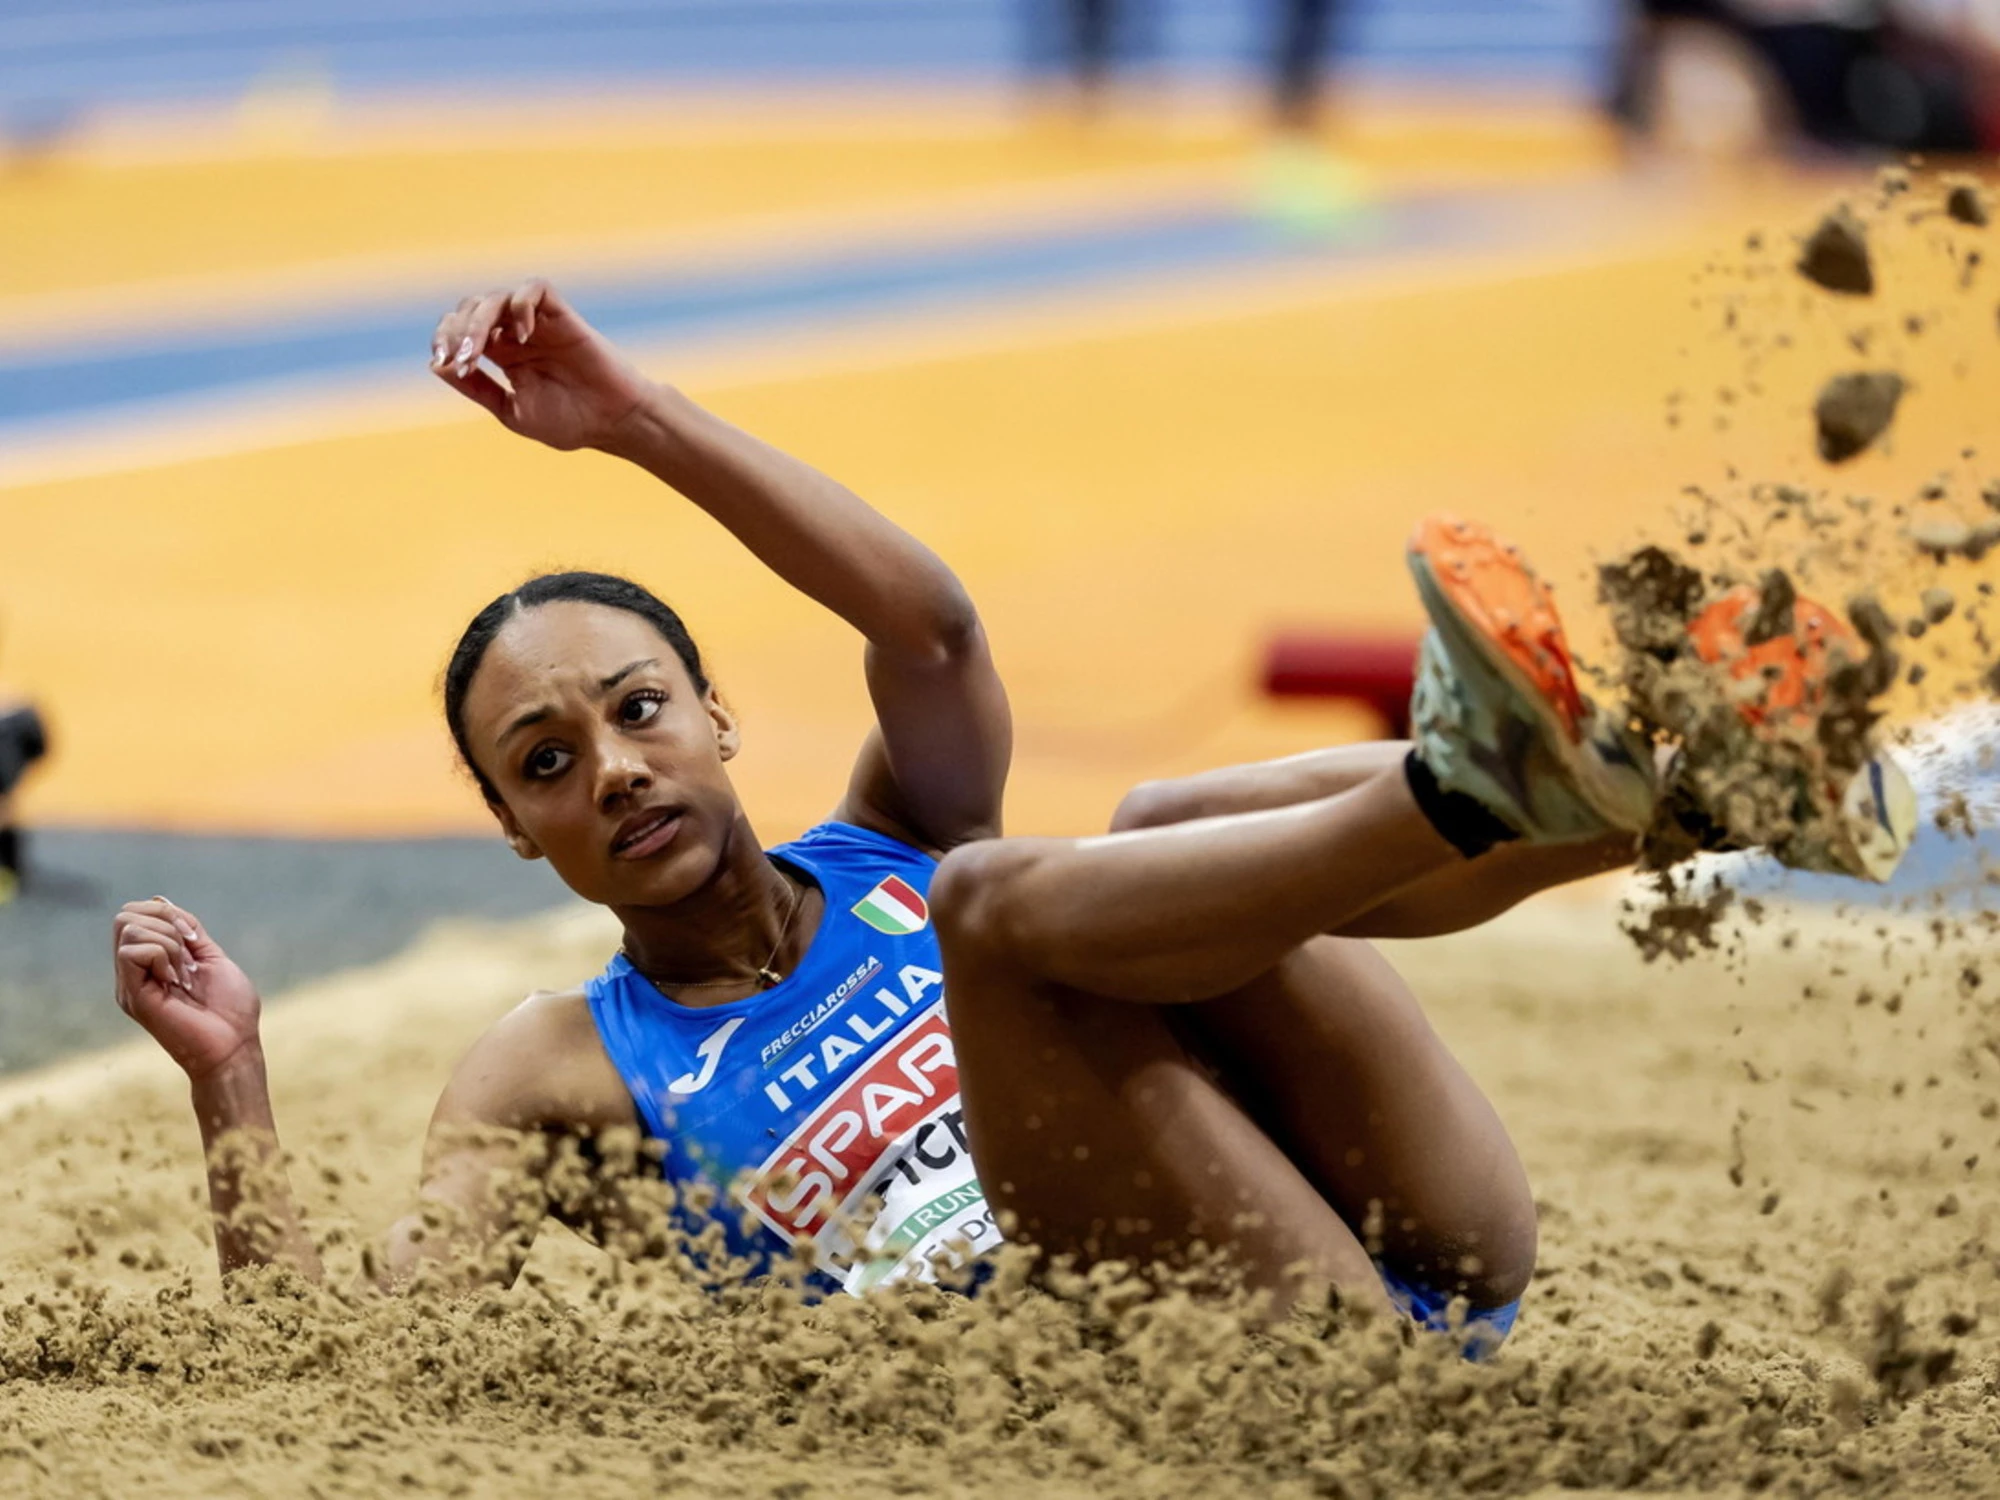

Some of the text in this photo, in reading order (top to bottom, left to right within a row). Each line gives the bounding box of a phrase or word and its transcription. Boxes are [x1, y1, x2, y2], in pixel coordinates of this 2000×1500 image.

[761, 955, 880, 1063] FRECCIAROSSA
[764, 964, 944, 1113] ITALIA
[766, 1032, 957, 1228] SPAR
[914, 1186, 982, 1228] RUN
